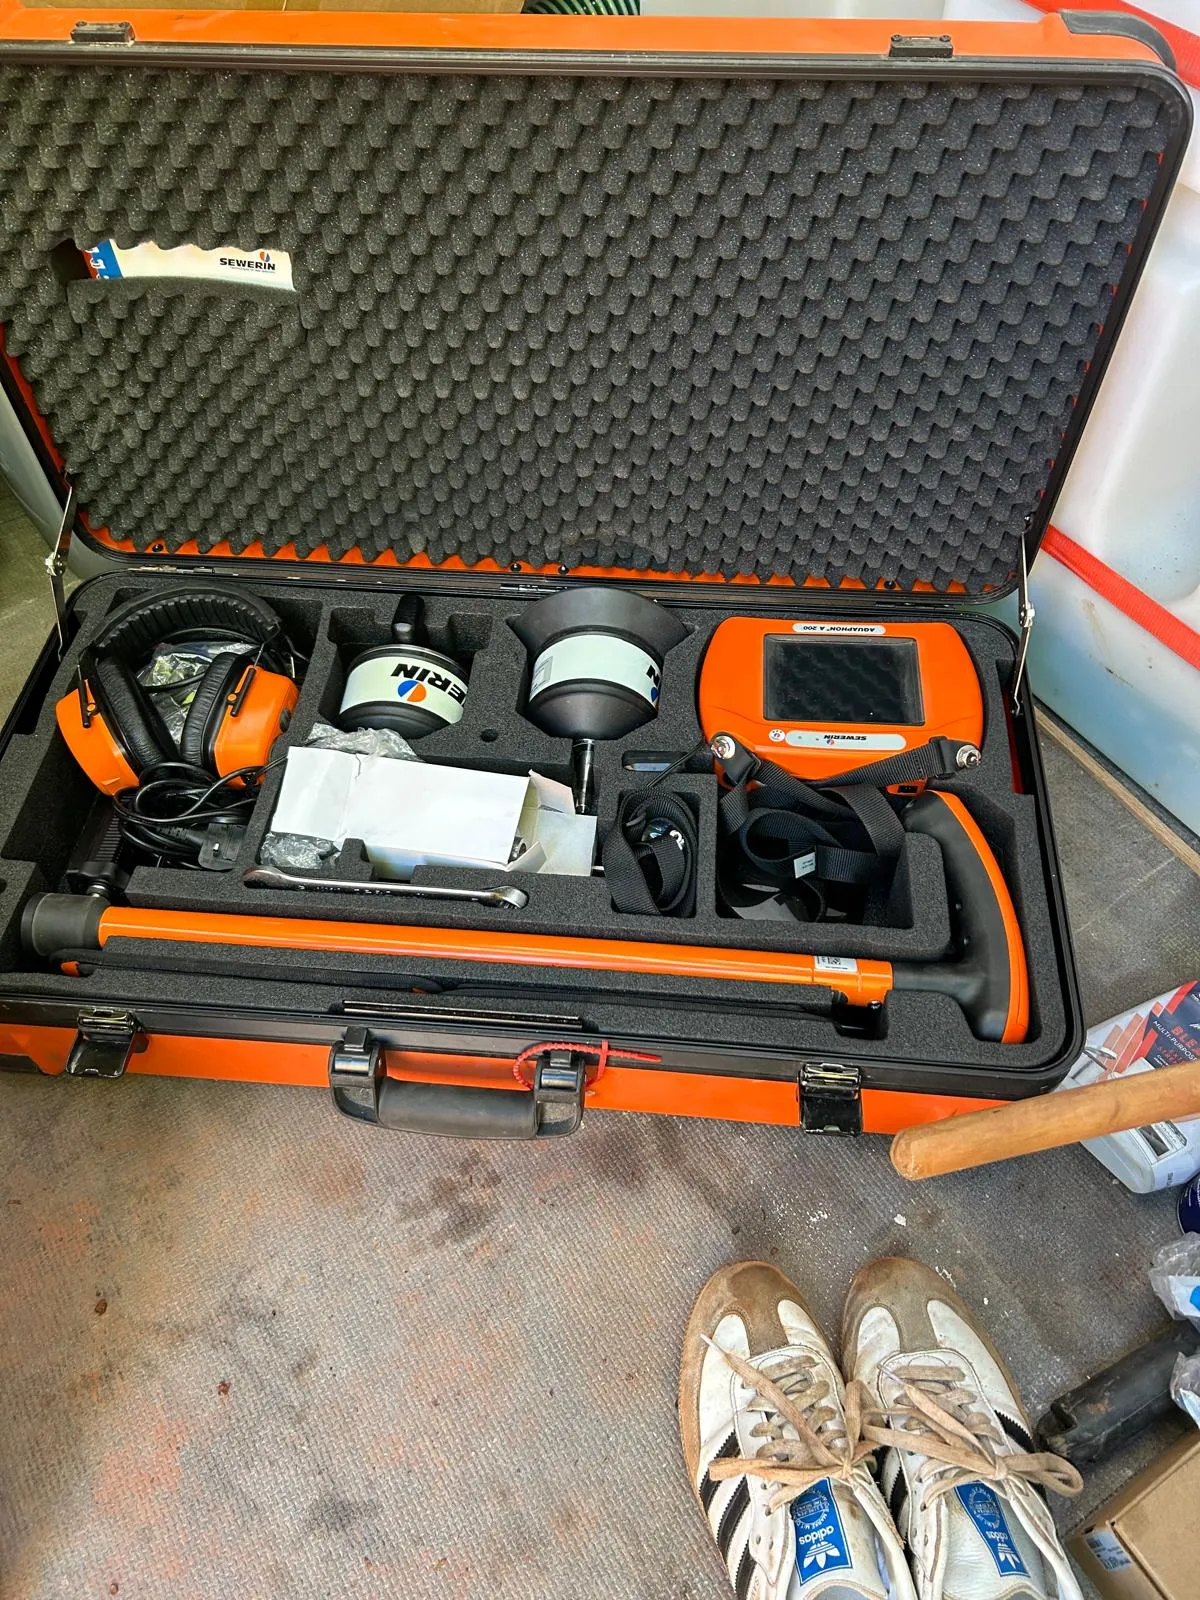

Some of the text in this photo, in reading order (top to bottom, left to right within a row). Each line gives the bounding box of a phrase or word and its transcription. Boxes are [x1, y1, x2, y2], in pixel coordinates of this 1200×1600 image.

[219, 257, 276, 270] SEWERIN
[798, 1525, 835, 1545] adidas
[985, 1530, 1009, 1543] adidas
